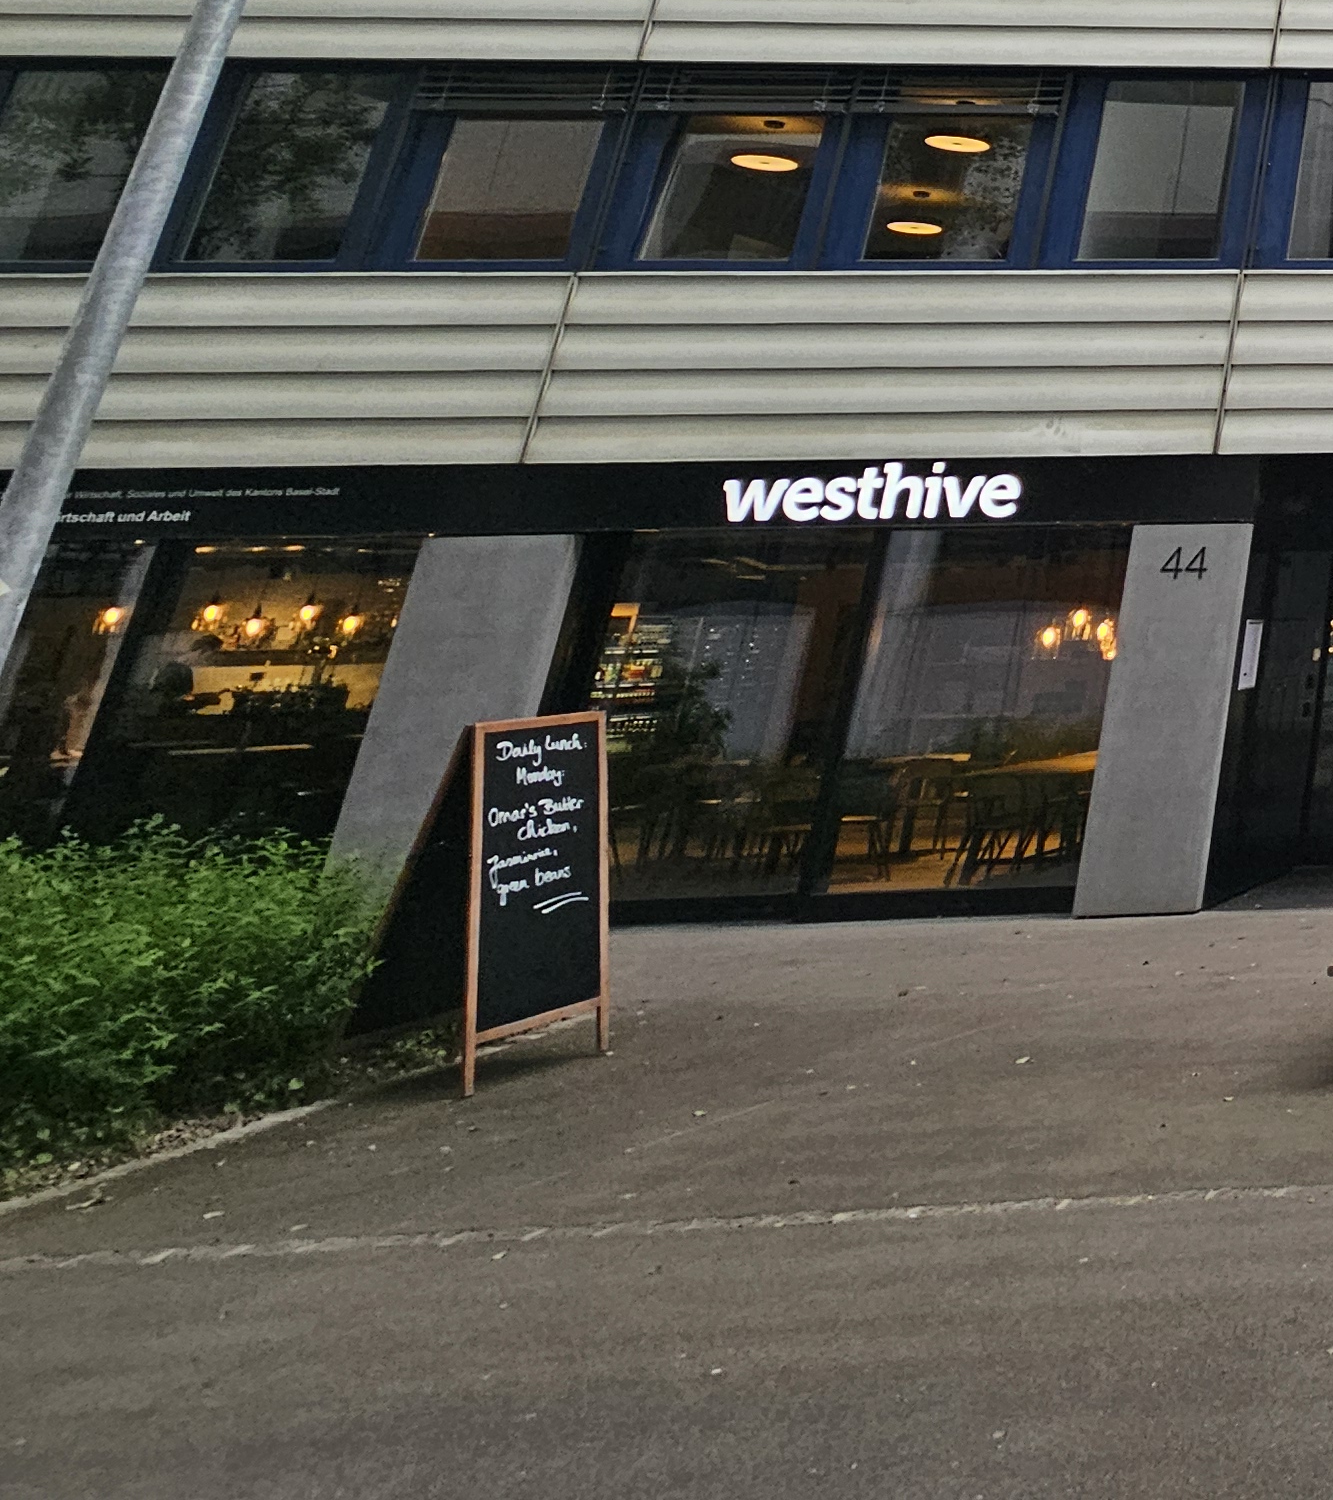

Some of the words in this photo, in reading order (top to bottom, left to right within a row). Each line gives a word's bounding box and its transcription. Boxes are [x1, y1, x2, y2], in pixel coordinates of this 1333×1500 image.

[168, 489, 187, 498] und
[225, 488, 242, 497] des
[244, 487, 284, 497] Kantons
[723, 461, 1022, 522] westhive
[57, 511, 115, 523] rtschaft
[117, 511, 145, 523] und
[147, 509, 192, 522] Arbeit
[1160, 546, 1208, 580] 44
[496, 739, 542, 766] Daily
[488, 802, 538, 827] Omar's
[497, 879, 530, 906] green
[535, 866, 572, 886] beans
